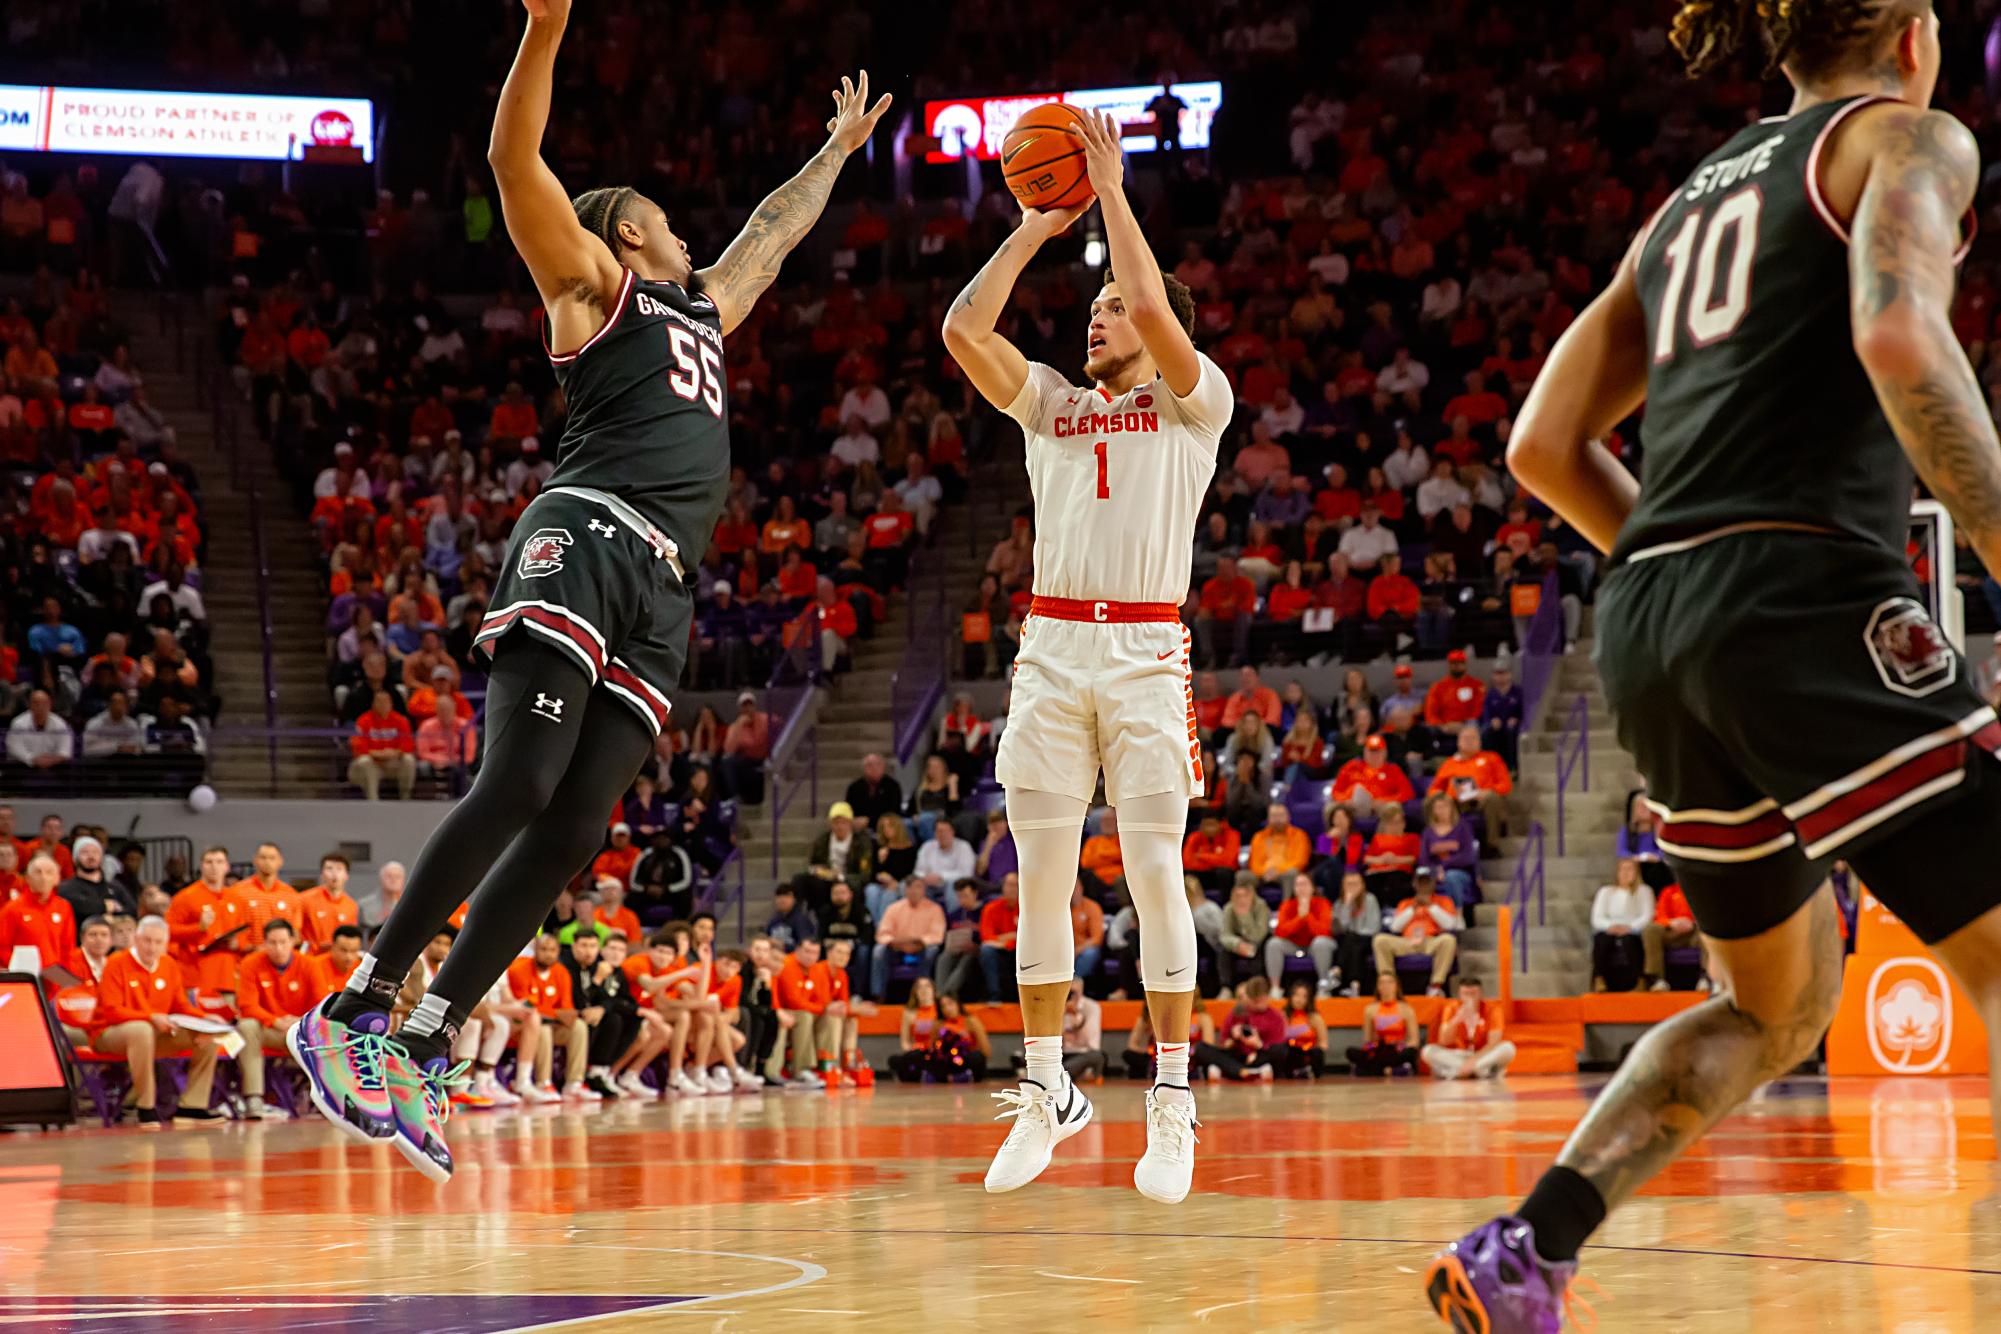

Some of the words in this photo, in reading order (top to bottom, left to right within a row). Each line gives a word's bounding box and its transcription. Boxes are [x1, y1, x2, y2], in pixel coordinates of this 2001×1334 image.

[63, 102, 146, 120] PROUD
[155, 106, 258, 123] PARTNER
[267, 111, 295, 123] OF
[64, 123, 175, 140] CLEMSON
[184, 127, 297, 145] ATHLETIC
[1654, 182, 1764, 364] 10
[665, 321, 723, 420] 55
[1054, 411, 1159, 438] CLEMSON
[1093, 442, 1110, 500] 1
[1094, 602, 1108, 622] C
